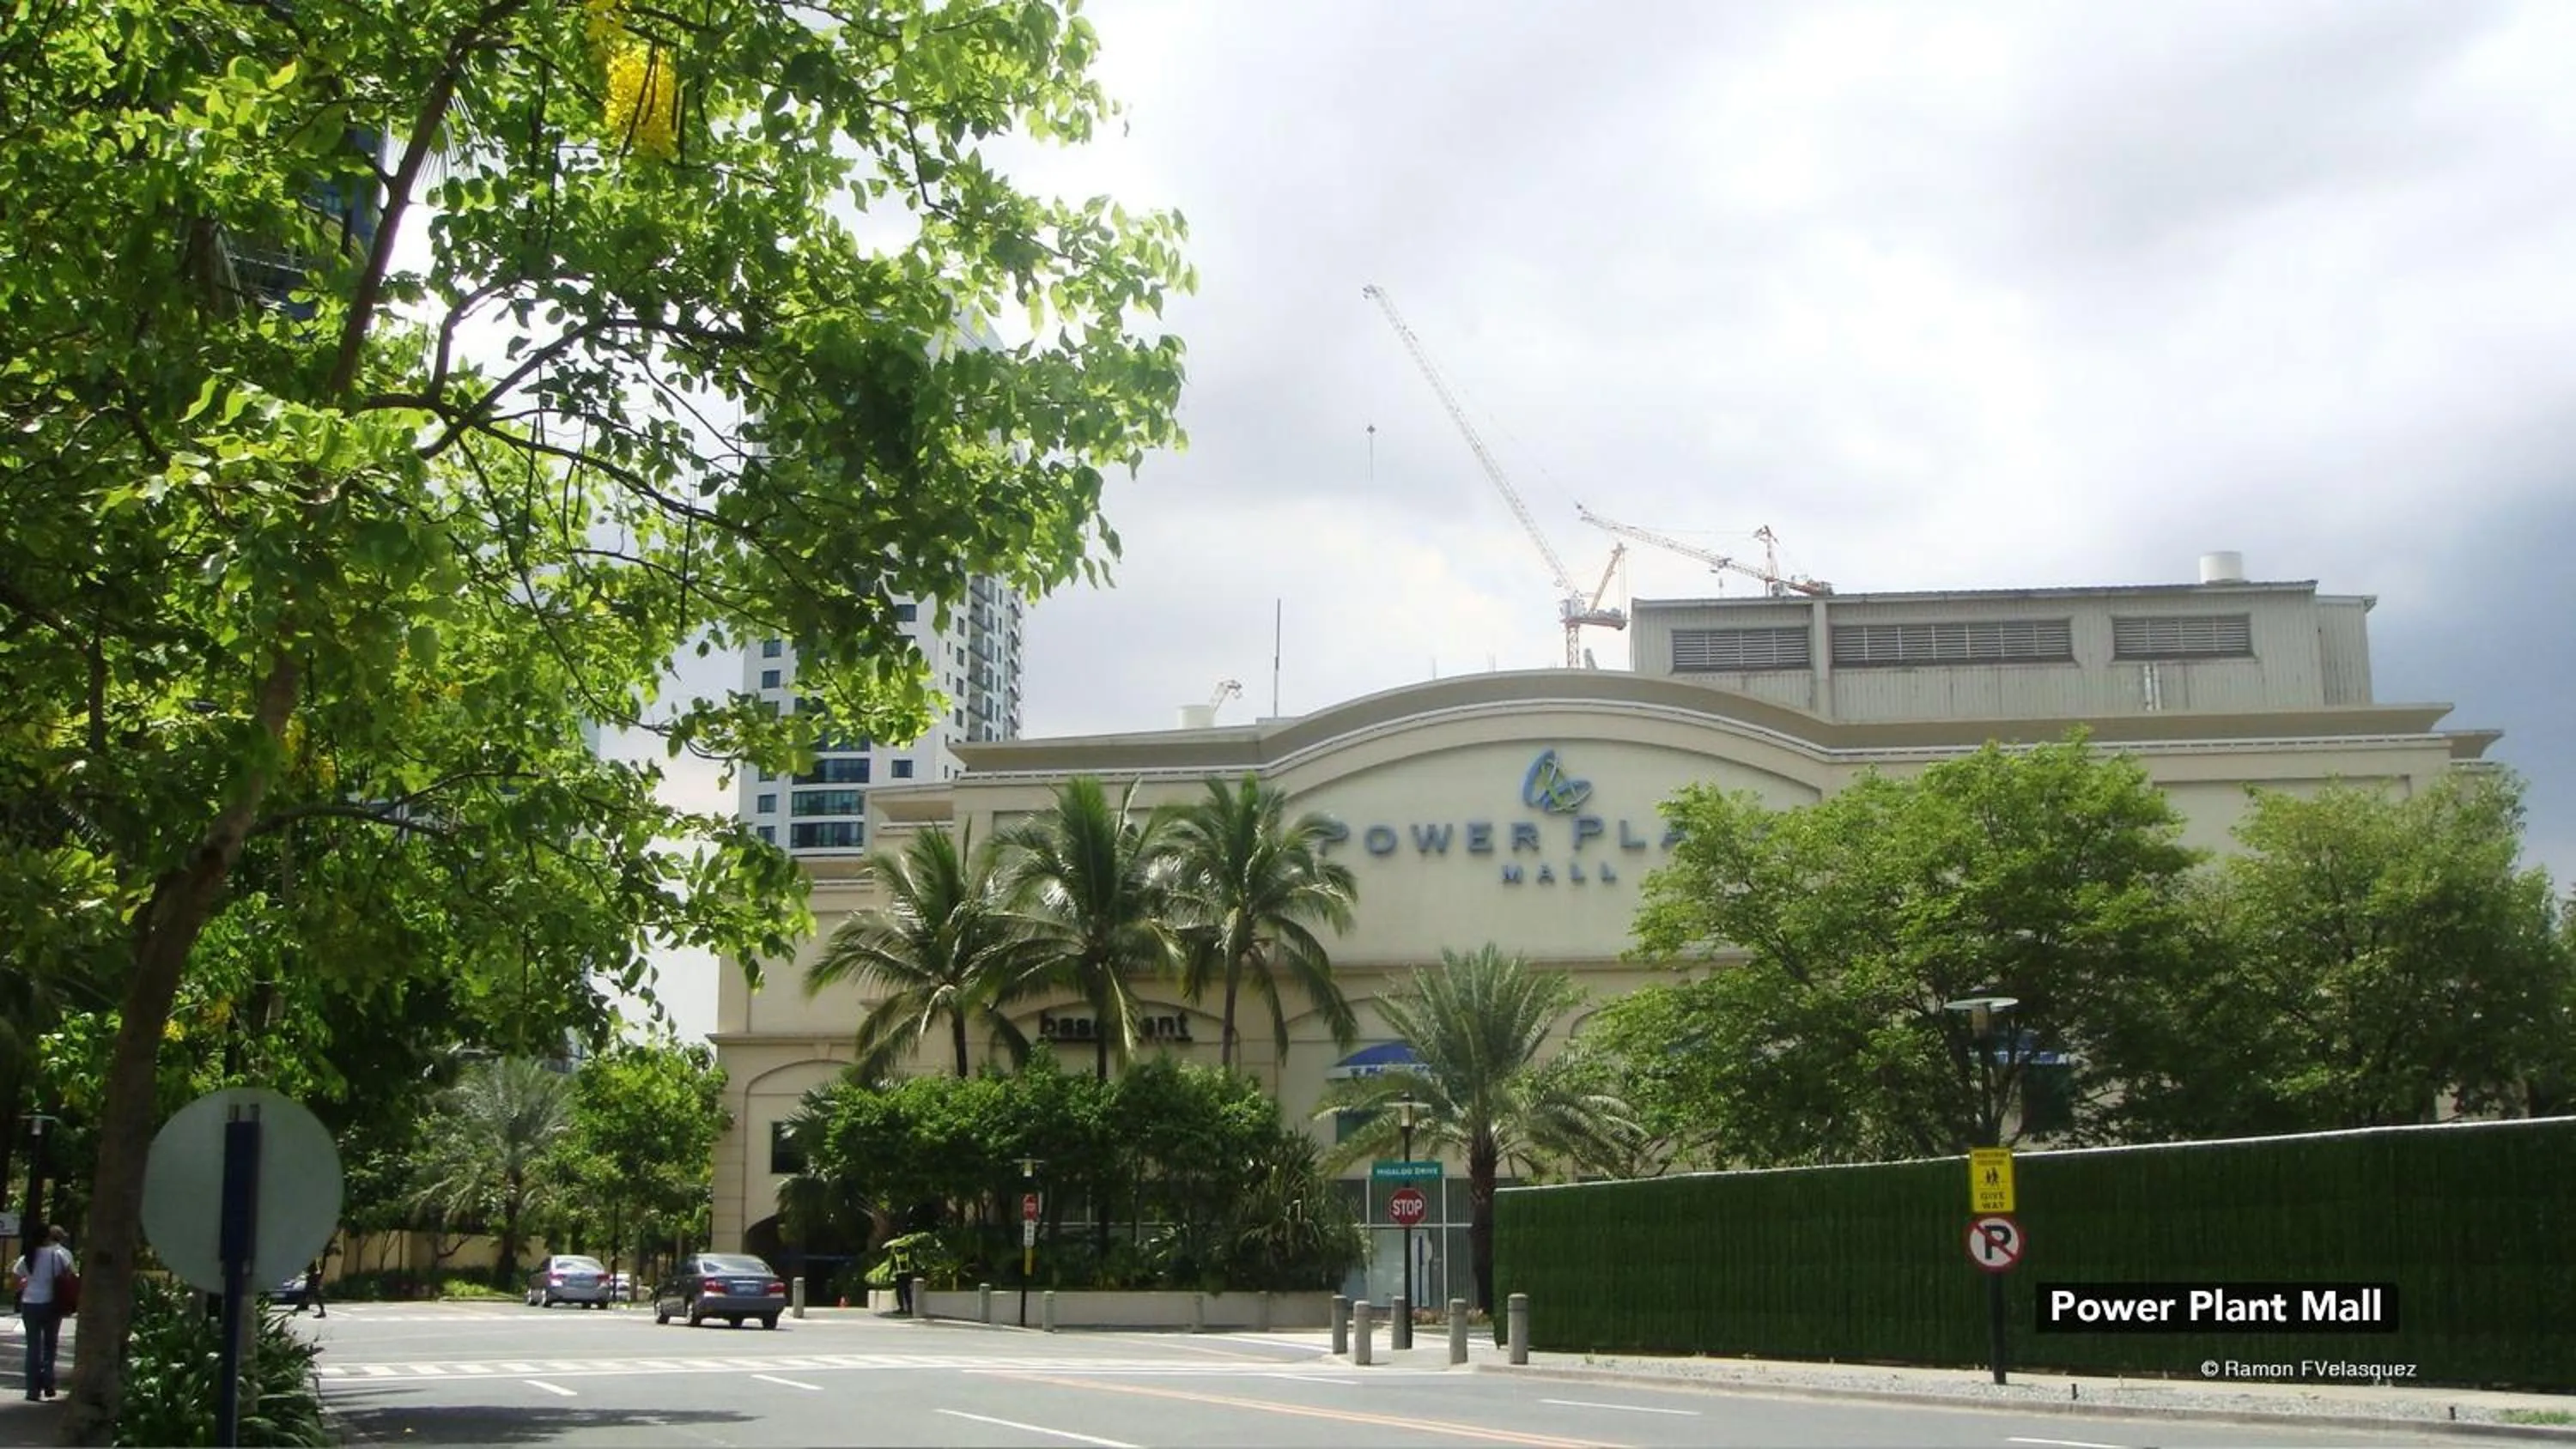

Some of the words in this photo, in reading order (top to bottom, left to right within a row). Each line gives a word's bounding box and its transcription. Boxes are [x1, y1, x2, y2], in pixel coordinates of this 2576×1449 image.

[1501, 864, 1618, 885] MALL
[1392, 1198, 1423, 1216] STOP
[1981, 1201, 2005, 1210] WAY
[1984, 1224, 2012, 1260] P
